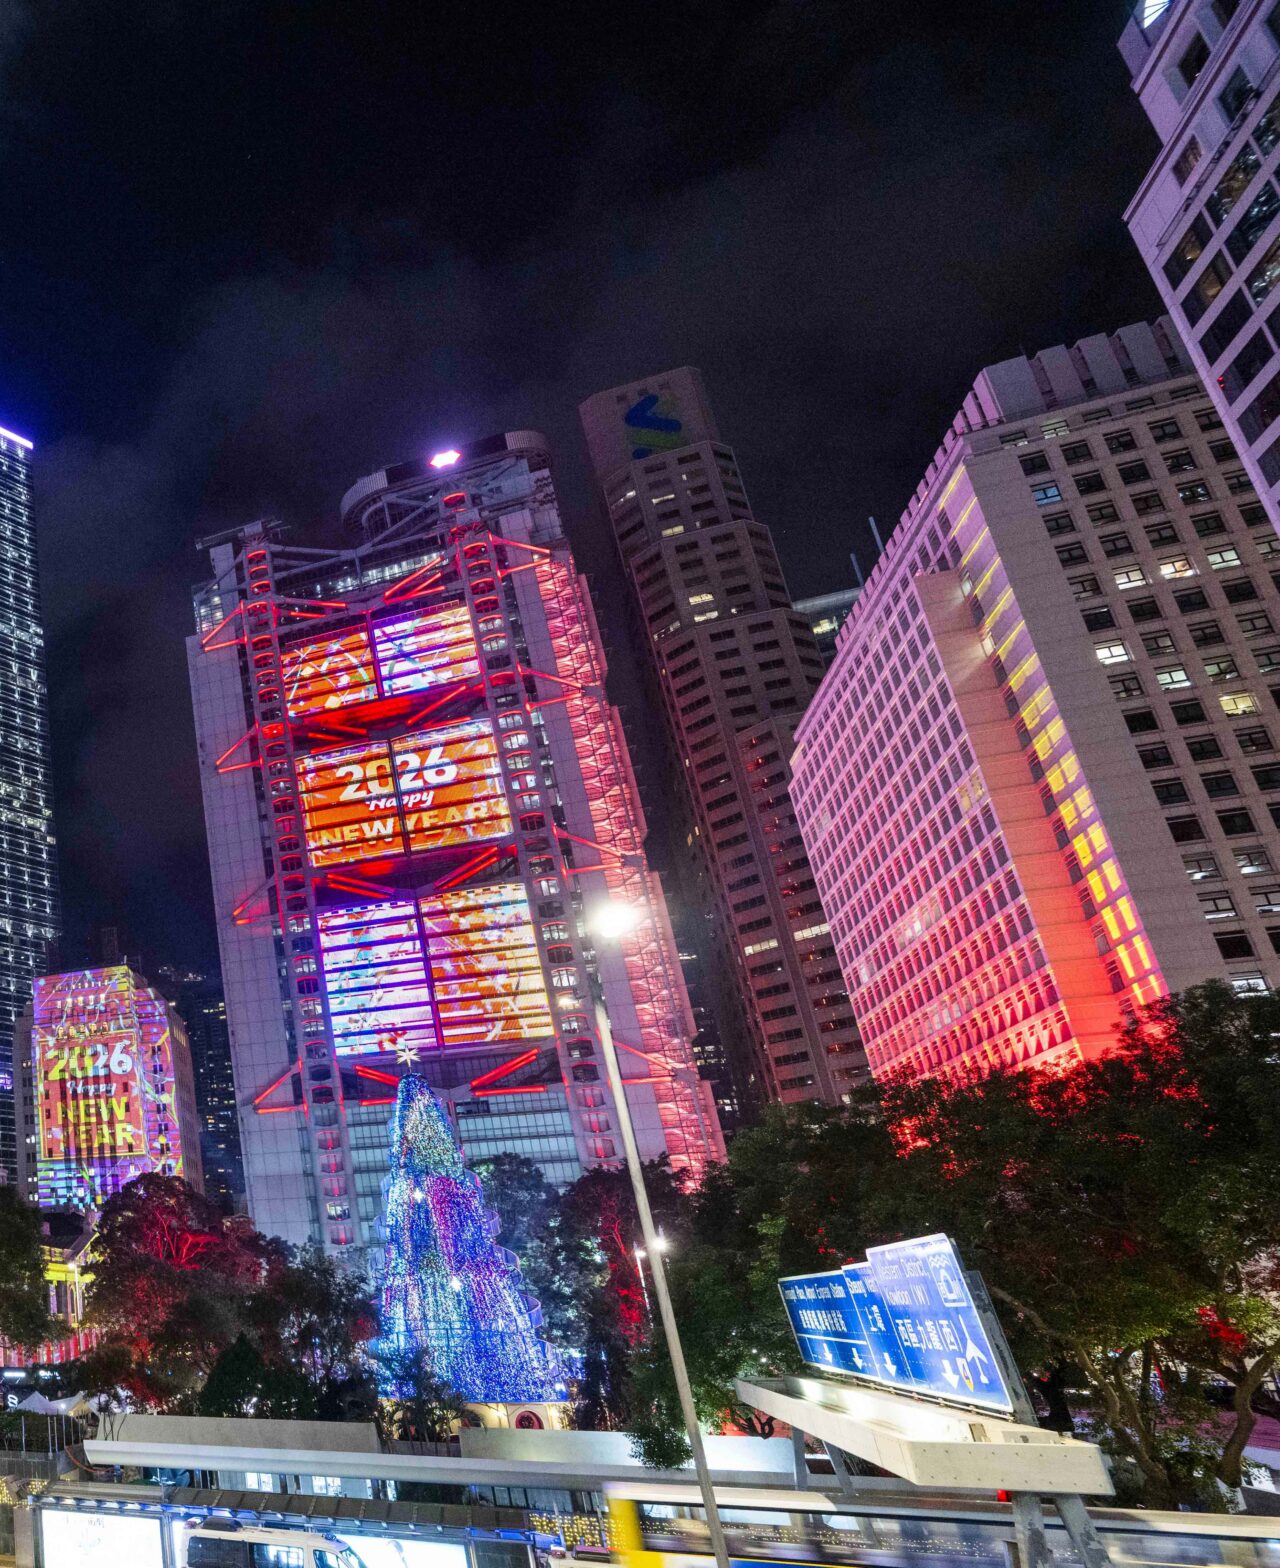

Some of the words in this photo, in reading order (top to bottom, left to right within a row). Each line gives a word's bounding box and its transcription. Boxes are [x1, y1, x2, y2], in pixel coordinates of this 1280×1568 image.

[335, 747, 459, 802] 2026
[365, 790, 435, 812] Happy
[319, 814, 396, 848] NEW
[403, 803, 490, 839] YEAR
[44, 1040, 133, 1081] 2026
[66, 1080, 117, 1097] Happy
[57, 1097, 128, 1125] NEW
